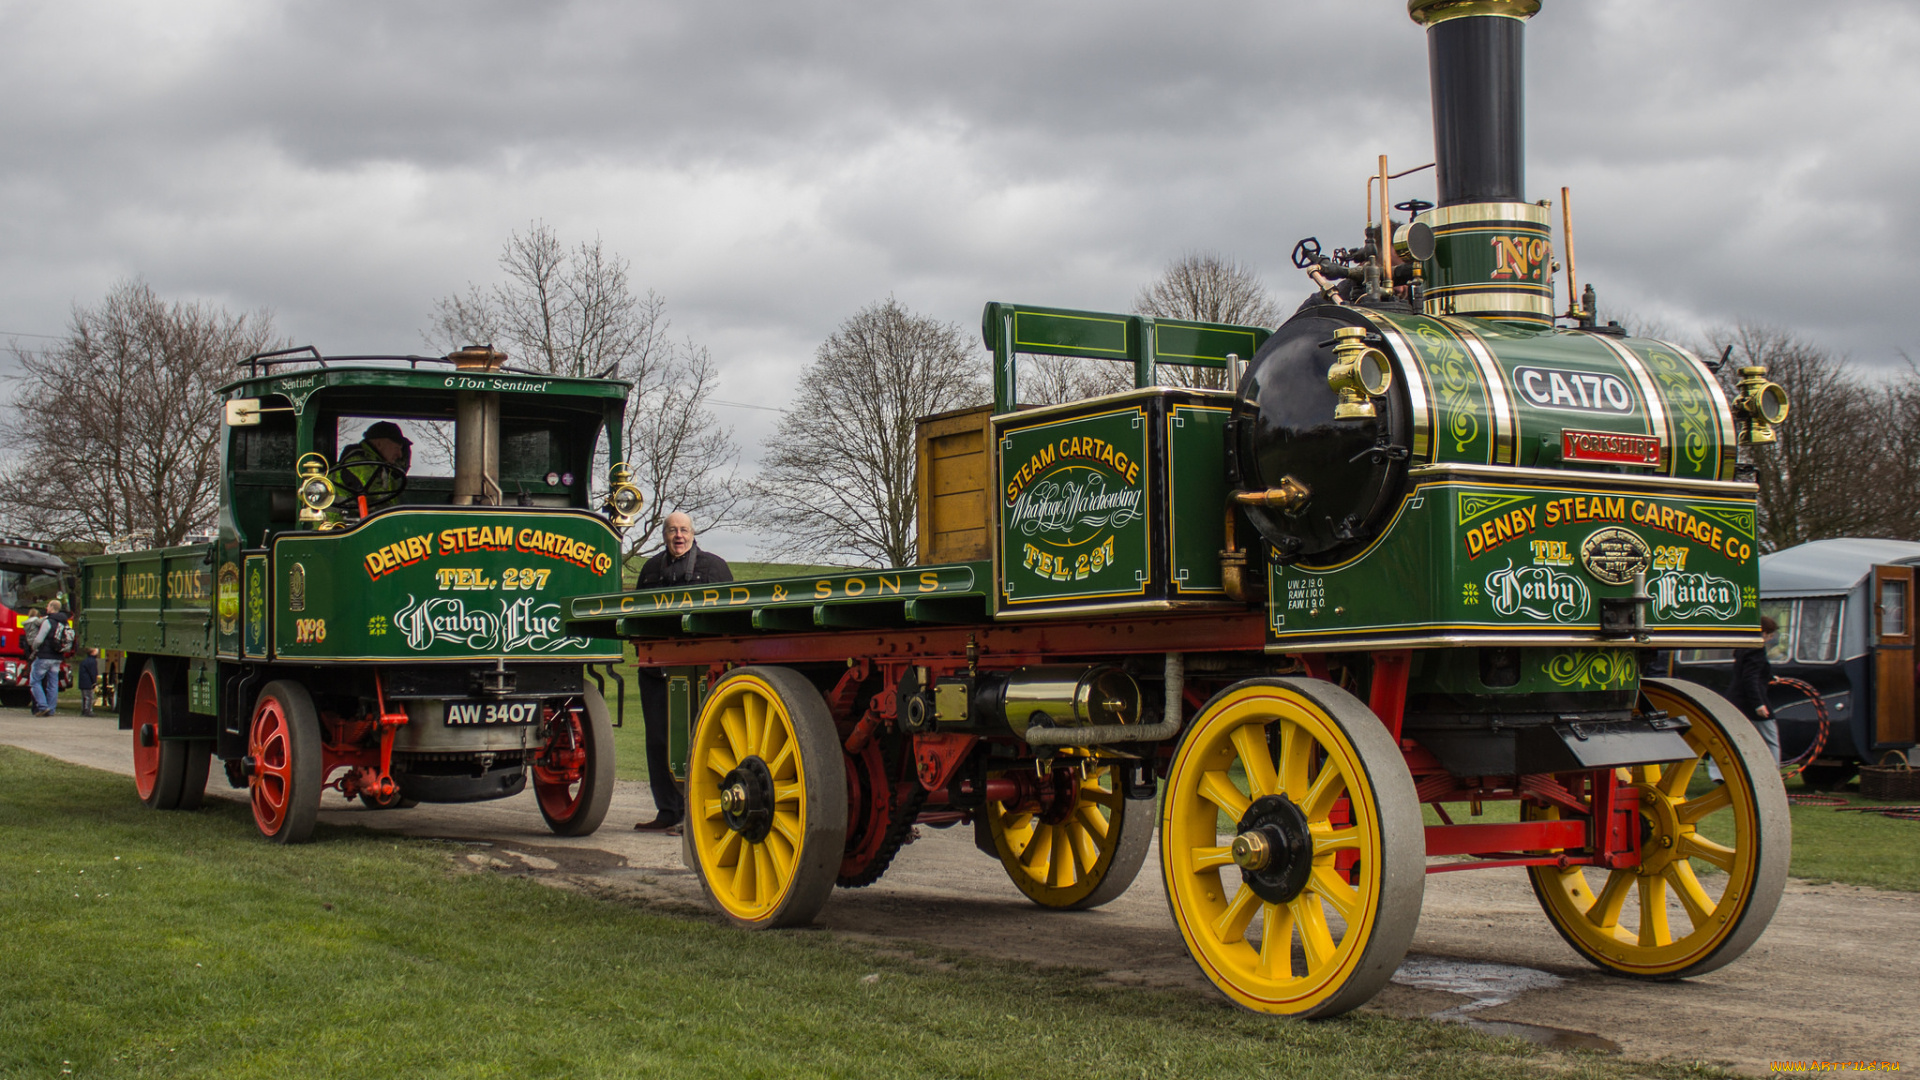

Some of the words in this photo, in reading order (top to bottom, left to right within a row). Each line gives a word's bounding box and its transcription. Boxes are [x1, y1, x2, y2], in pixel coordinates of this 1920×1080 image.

[444, 376, 455, 388] 6
[458, 377, 486, 389] Ton
[1522, 370, 1629, 411] CA170
[1565, 432, 1659, 463] YORKSHIRE
[1006, 443, 1057, 503] STEAM
[1058, 436, 1141, 486] CARTAGE
[1062, 477, 1143, 525] Warehousing
[1464, 503, 1537, 561] DENBY
[1544, 496, 1625, 527] STEAM
[1630, 500, 1723, 553] CARTAGE
[364, 532, 434, 582] DENBY
[438, 526, 514, 556] STEAM
[515, 528, 596, 569] CARTAGE
[1023, 542, 1074, 581] TEL.
[1075, 535, 1115, 580] 237
[1530, 539, 1576, 567] TEL.
[1653, 545, 1690, 571] 237
[122, 572, 156, 599] WARD
[436, 567, 498, 591] TEL.
[502, 567, 552, 591] 237
[589, 599, 609, 615] J.
[620, 597, 641, 613] C.
[652, 587, 751, 610] WARD
[771, 583, 789, 602] &
[814, 572, 948, 599] SONS.
[1487, 562, 1586, 620] Denby
[1648, 571, 1738, 617] Maiden
[402, 596, 495, 651] Denby
[447, 704, 482, 725] AW
[485, 704, 538, 723] 3407
